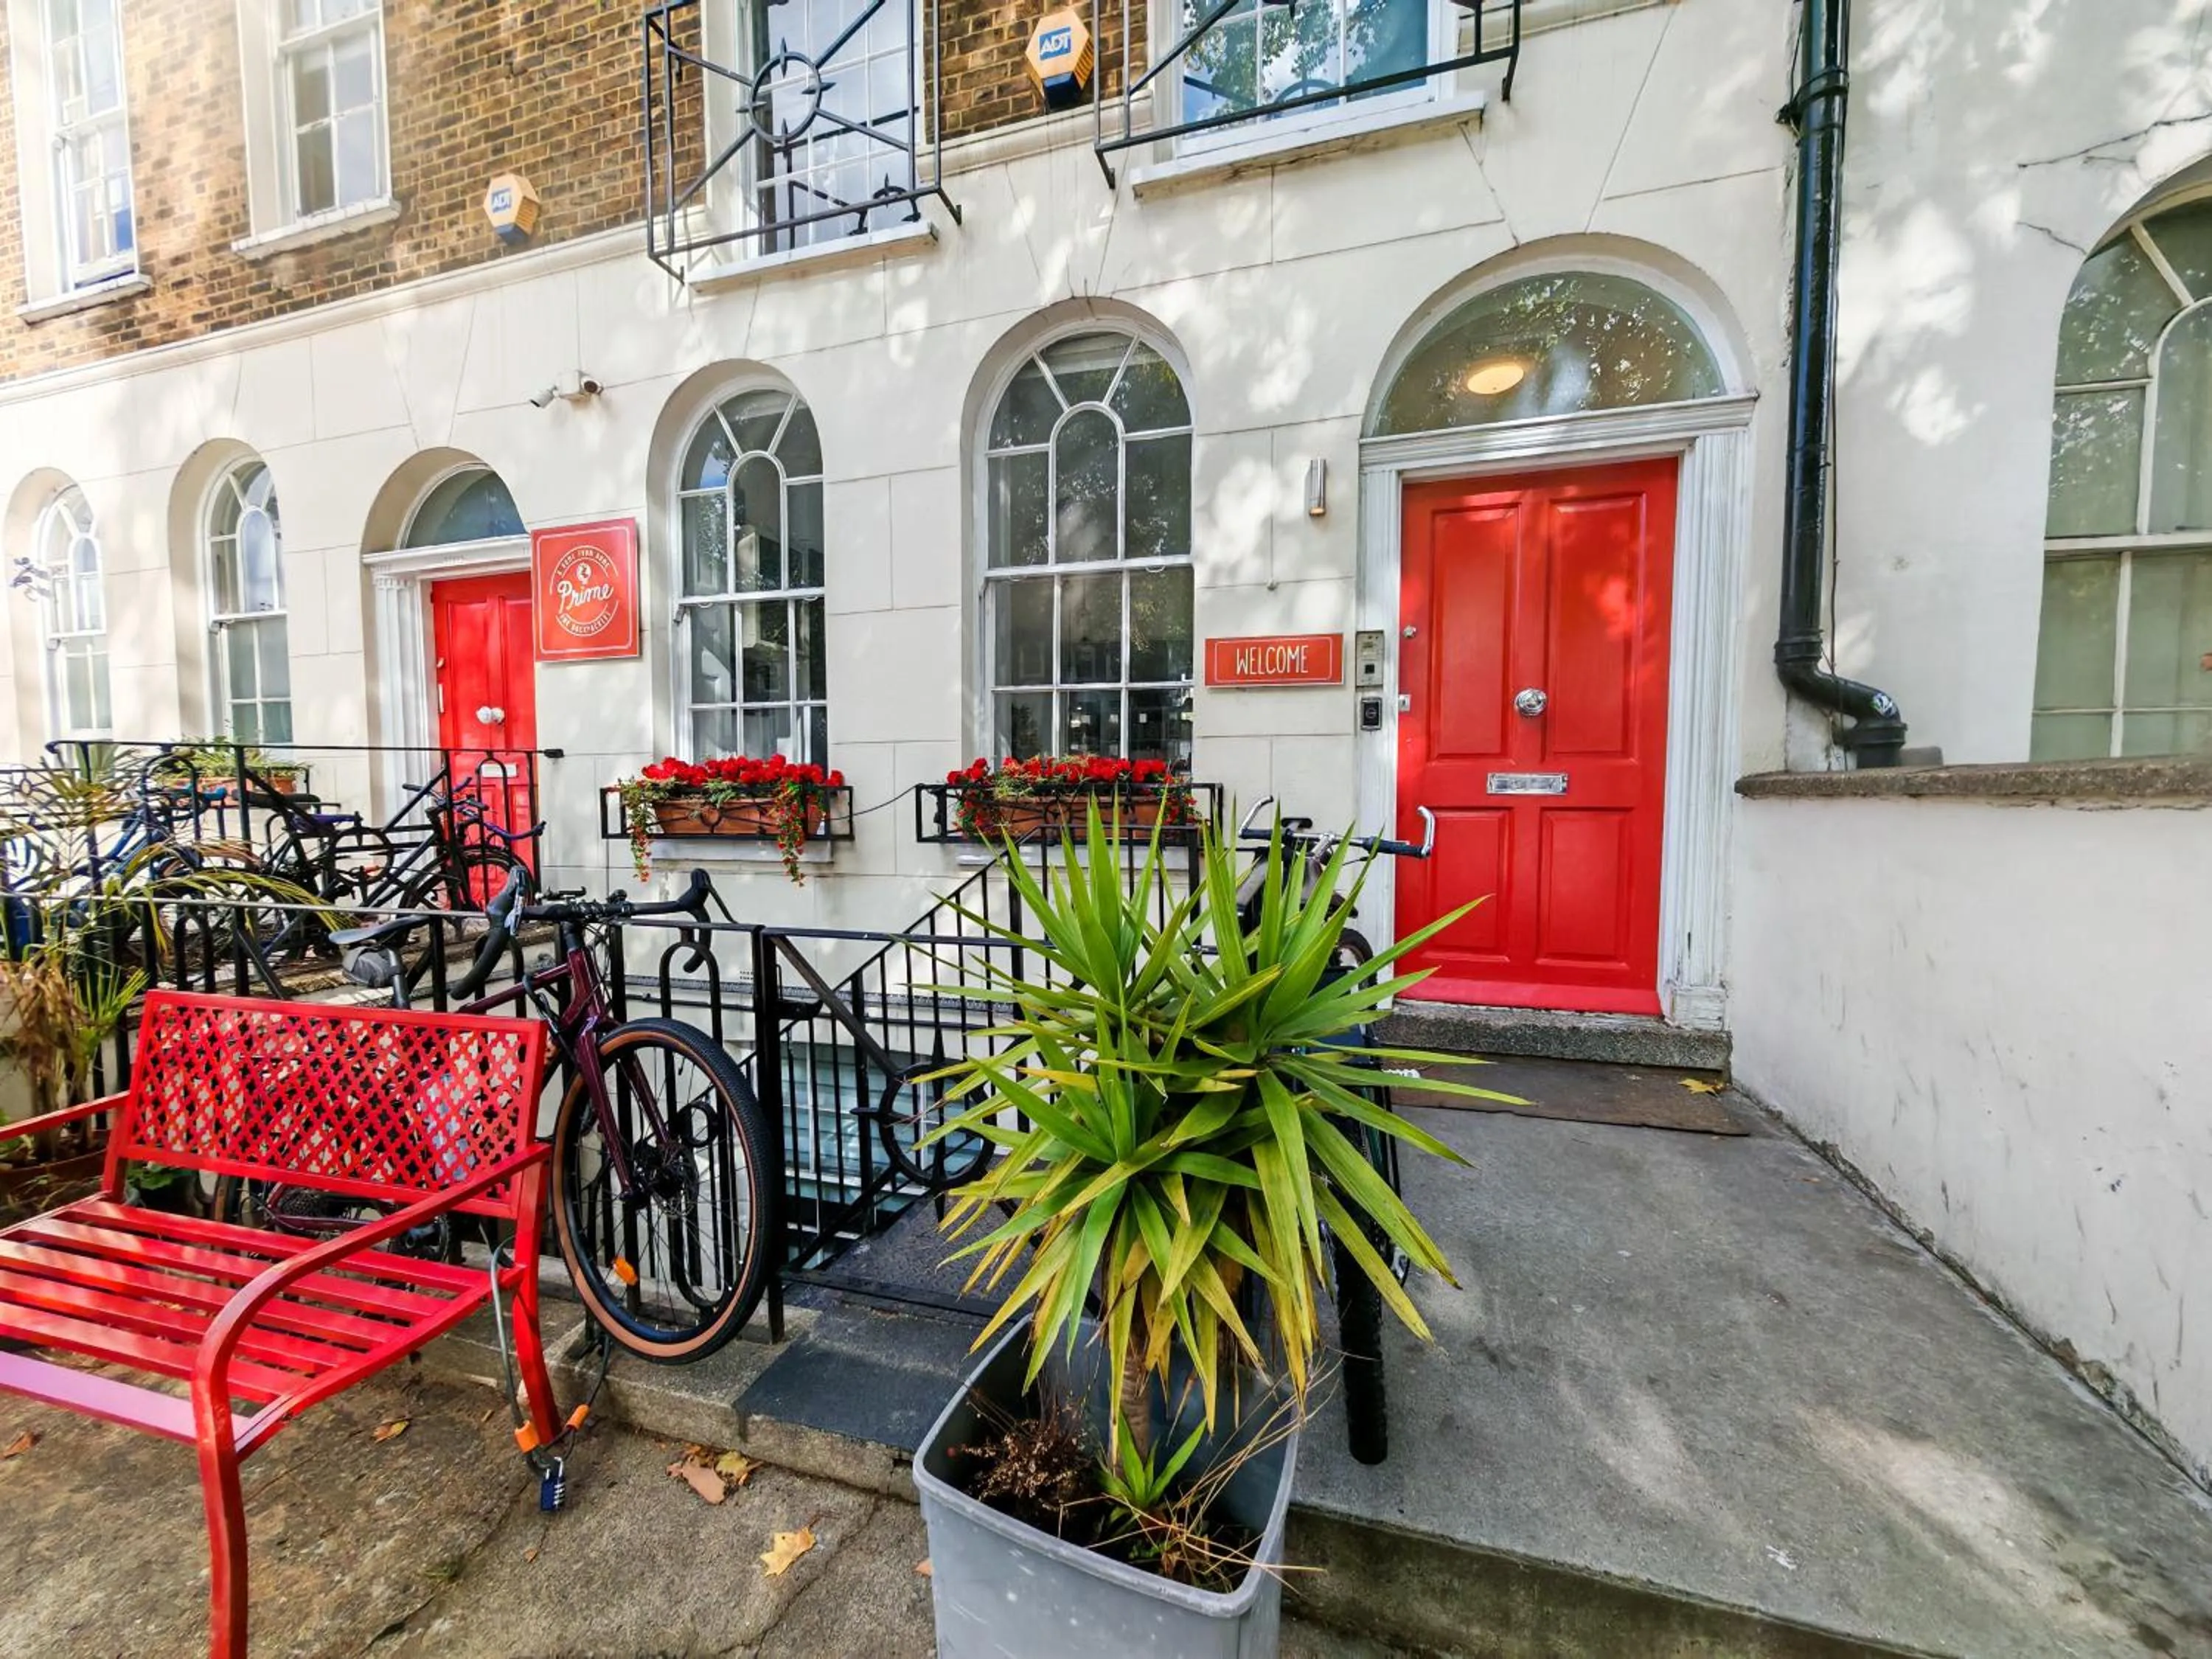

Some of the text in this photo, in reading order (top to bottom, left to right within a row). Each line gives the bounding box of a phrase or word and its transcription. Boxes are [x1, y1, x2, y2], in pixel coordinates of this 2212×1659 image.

[1040, 32, 1071, 56] ADT
[557, 580, 613, 614] Prime
[1236, 644, 1309, 675] WELCOME
